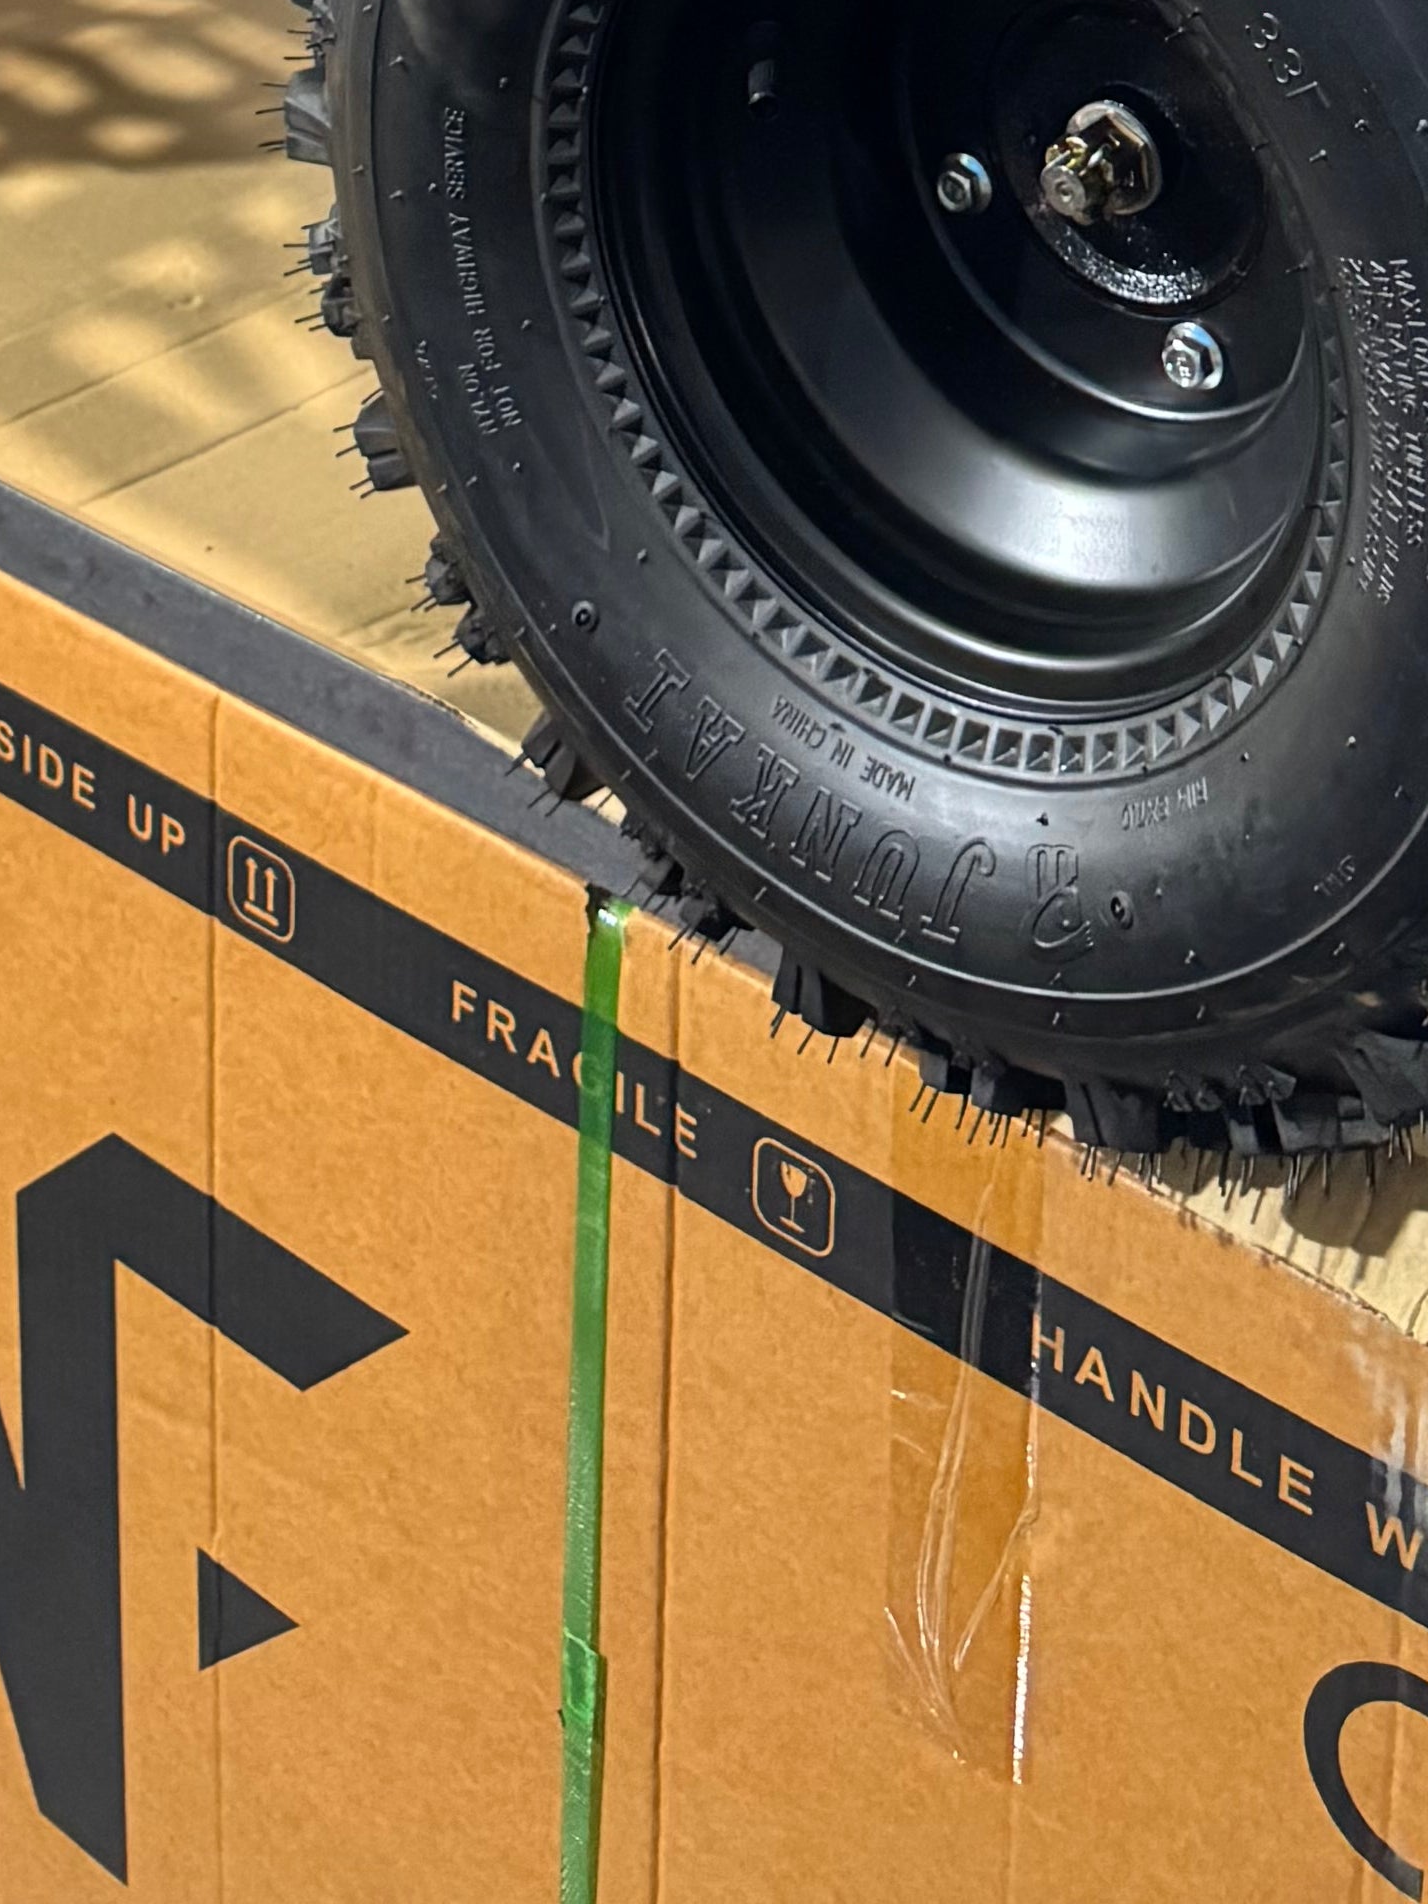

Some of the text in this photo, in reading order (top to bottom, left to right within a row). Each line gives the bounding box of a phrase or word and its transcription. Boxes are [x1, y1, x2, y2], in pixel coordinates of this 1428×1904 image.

[444, 107, 522, 427] NOT FOR HIGHWAY SERVICE
[127, 791, 187, 855] UP
[623, 649, 997, 945] JUNKAI
[773, 695, 918, 803] MADE IN CHINA
[450, 979, 700, 1161] FRAGILE
[1031, 1311, 1317, 1517] HANDLE
